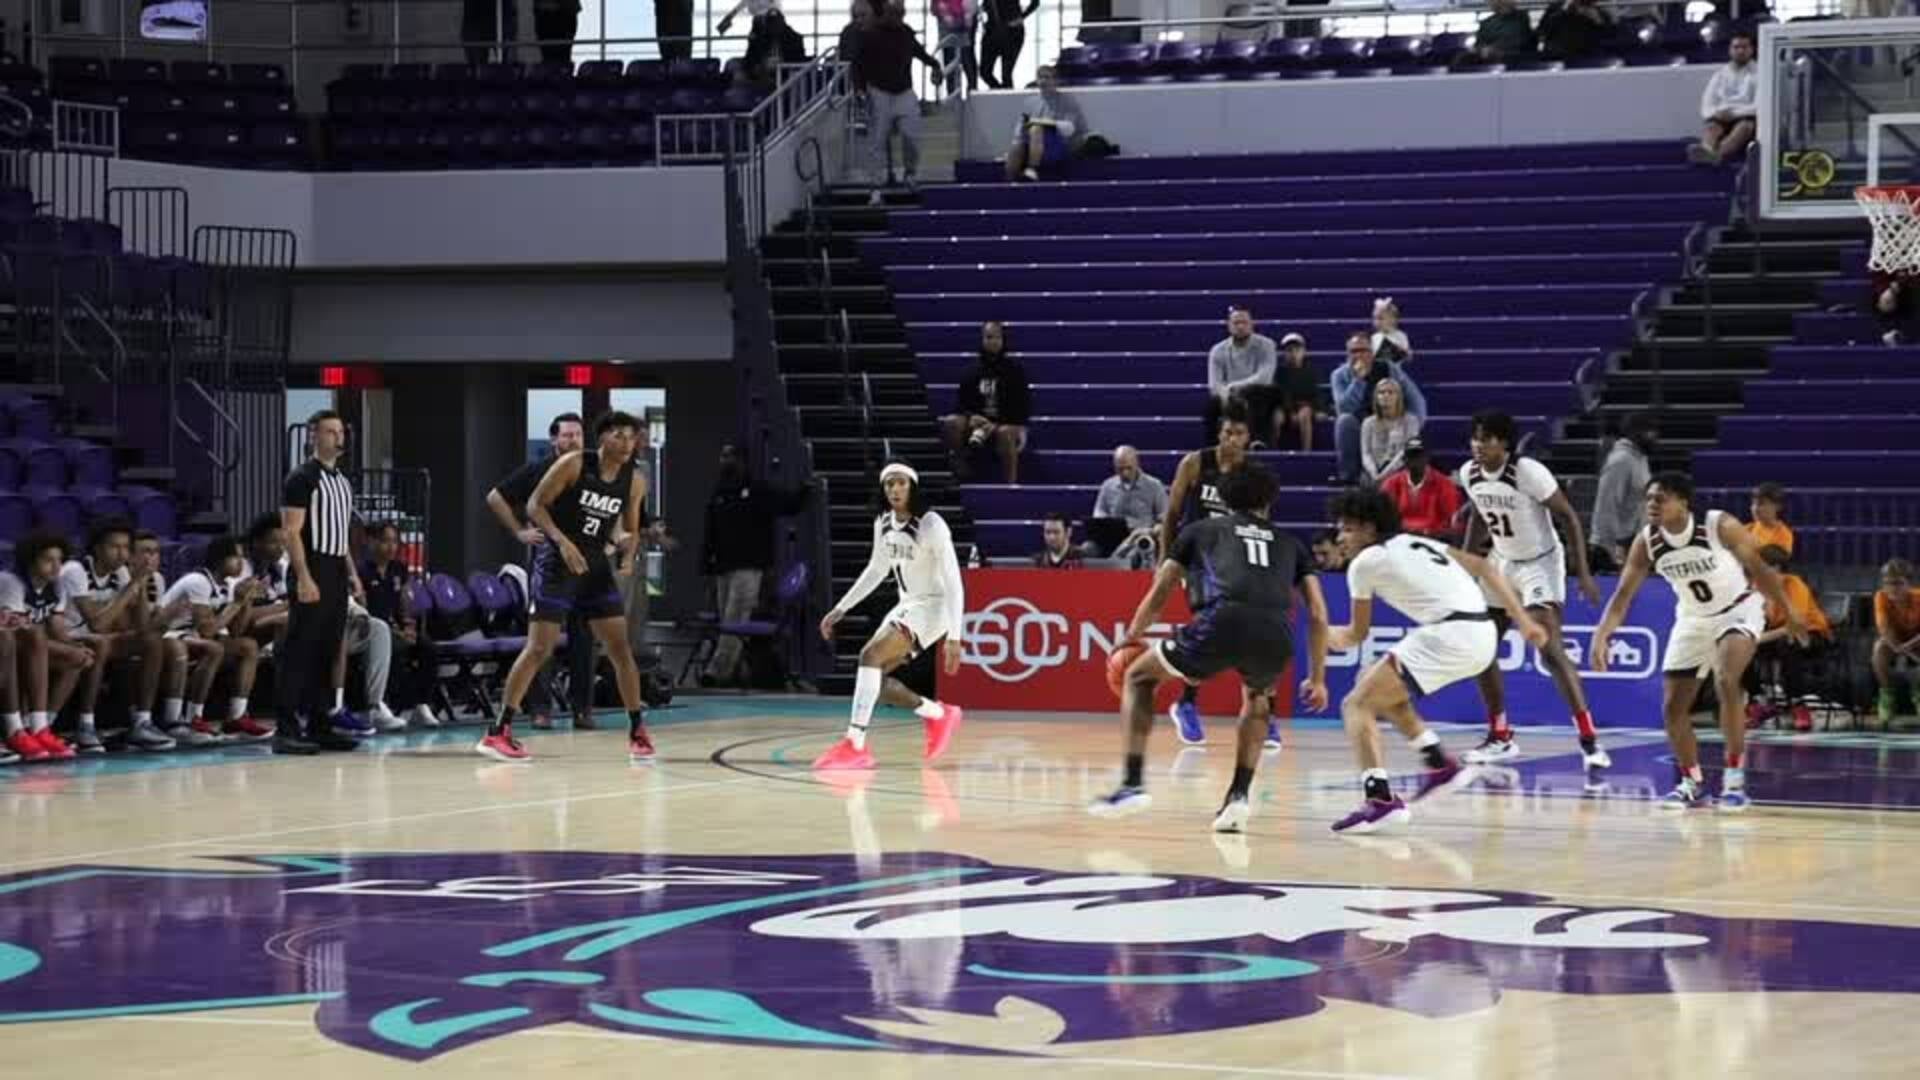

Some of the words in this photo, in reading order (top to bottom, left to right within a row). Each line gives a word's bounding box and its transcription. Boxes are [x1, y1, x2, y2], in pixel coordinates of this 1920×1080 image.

[579, 489, 622, 513] IMG
[582, 516, 601, 537] 21
[1487, 512, 1514, 537] 21
[1243, 538, 1269, 567] 11
[1410, 542, 1448, 566] 3
[1688, 579, 1713, 603] 0
